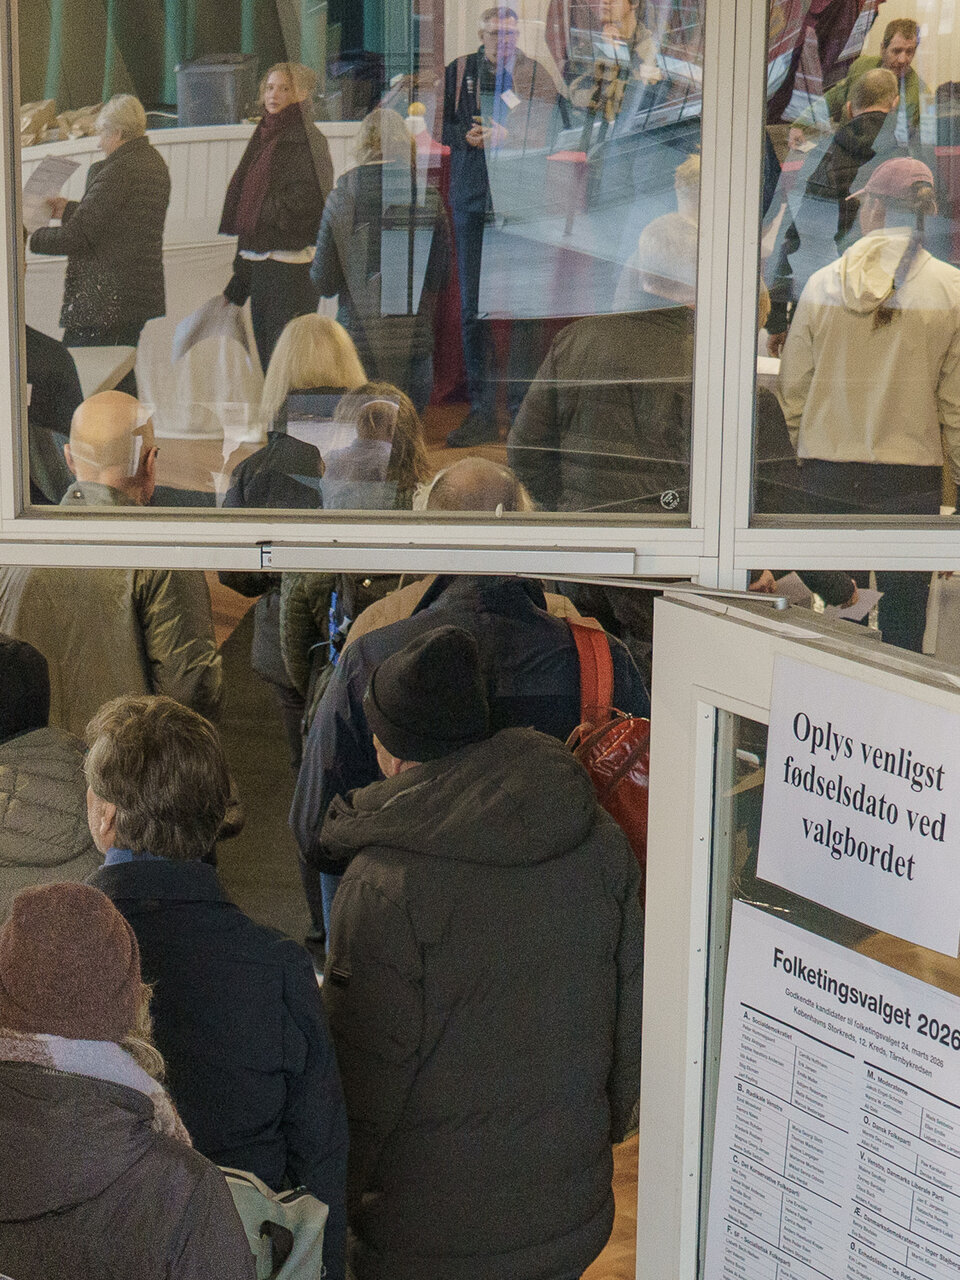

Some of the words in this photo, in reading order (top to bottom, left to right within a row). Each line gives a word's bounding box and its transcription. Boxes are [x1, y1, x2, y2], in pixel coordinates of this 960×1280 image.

[793, 711, 854, 761] Oplys
[860, 742, 945, 792] venligst
[783, 755, 899, 825] fødselsdato
[906, 809, 946, 842] ved
[802, 817, 916, 881] valgbordet
[773, 947, 912, 1029] Folketingsvalget
[916, 1011, 960, 1053] 2026
[752, 1016, 792, 1041] Socialdemokratiet
[784, 987, 814, 1009] Godkendte
[815, 1000, 845, 1023] kandidater
[853, 1020, 900, 1048] folketingsvalget
[911, 1045, 928, 1061] marts
[929, 1054, 944, 1069] 2026
[745, 1088, 765, 1103] Radikale
[766, 1099, 782, 1113] Venstre
[877, 1076, 908, 1097] Moderaterne
[749, 1164, 776, 1185] Konservative
[886, 1167, 910, 1185] Danmarks
[931, 1190, 944, 1202] Parti
[858, 1248, 887, 1269] Enhedslisten
